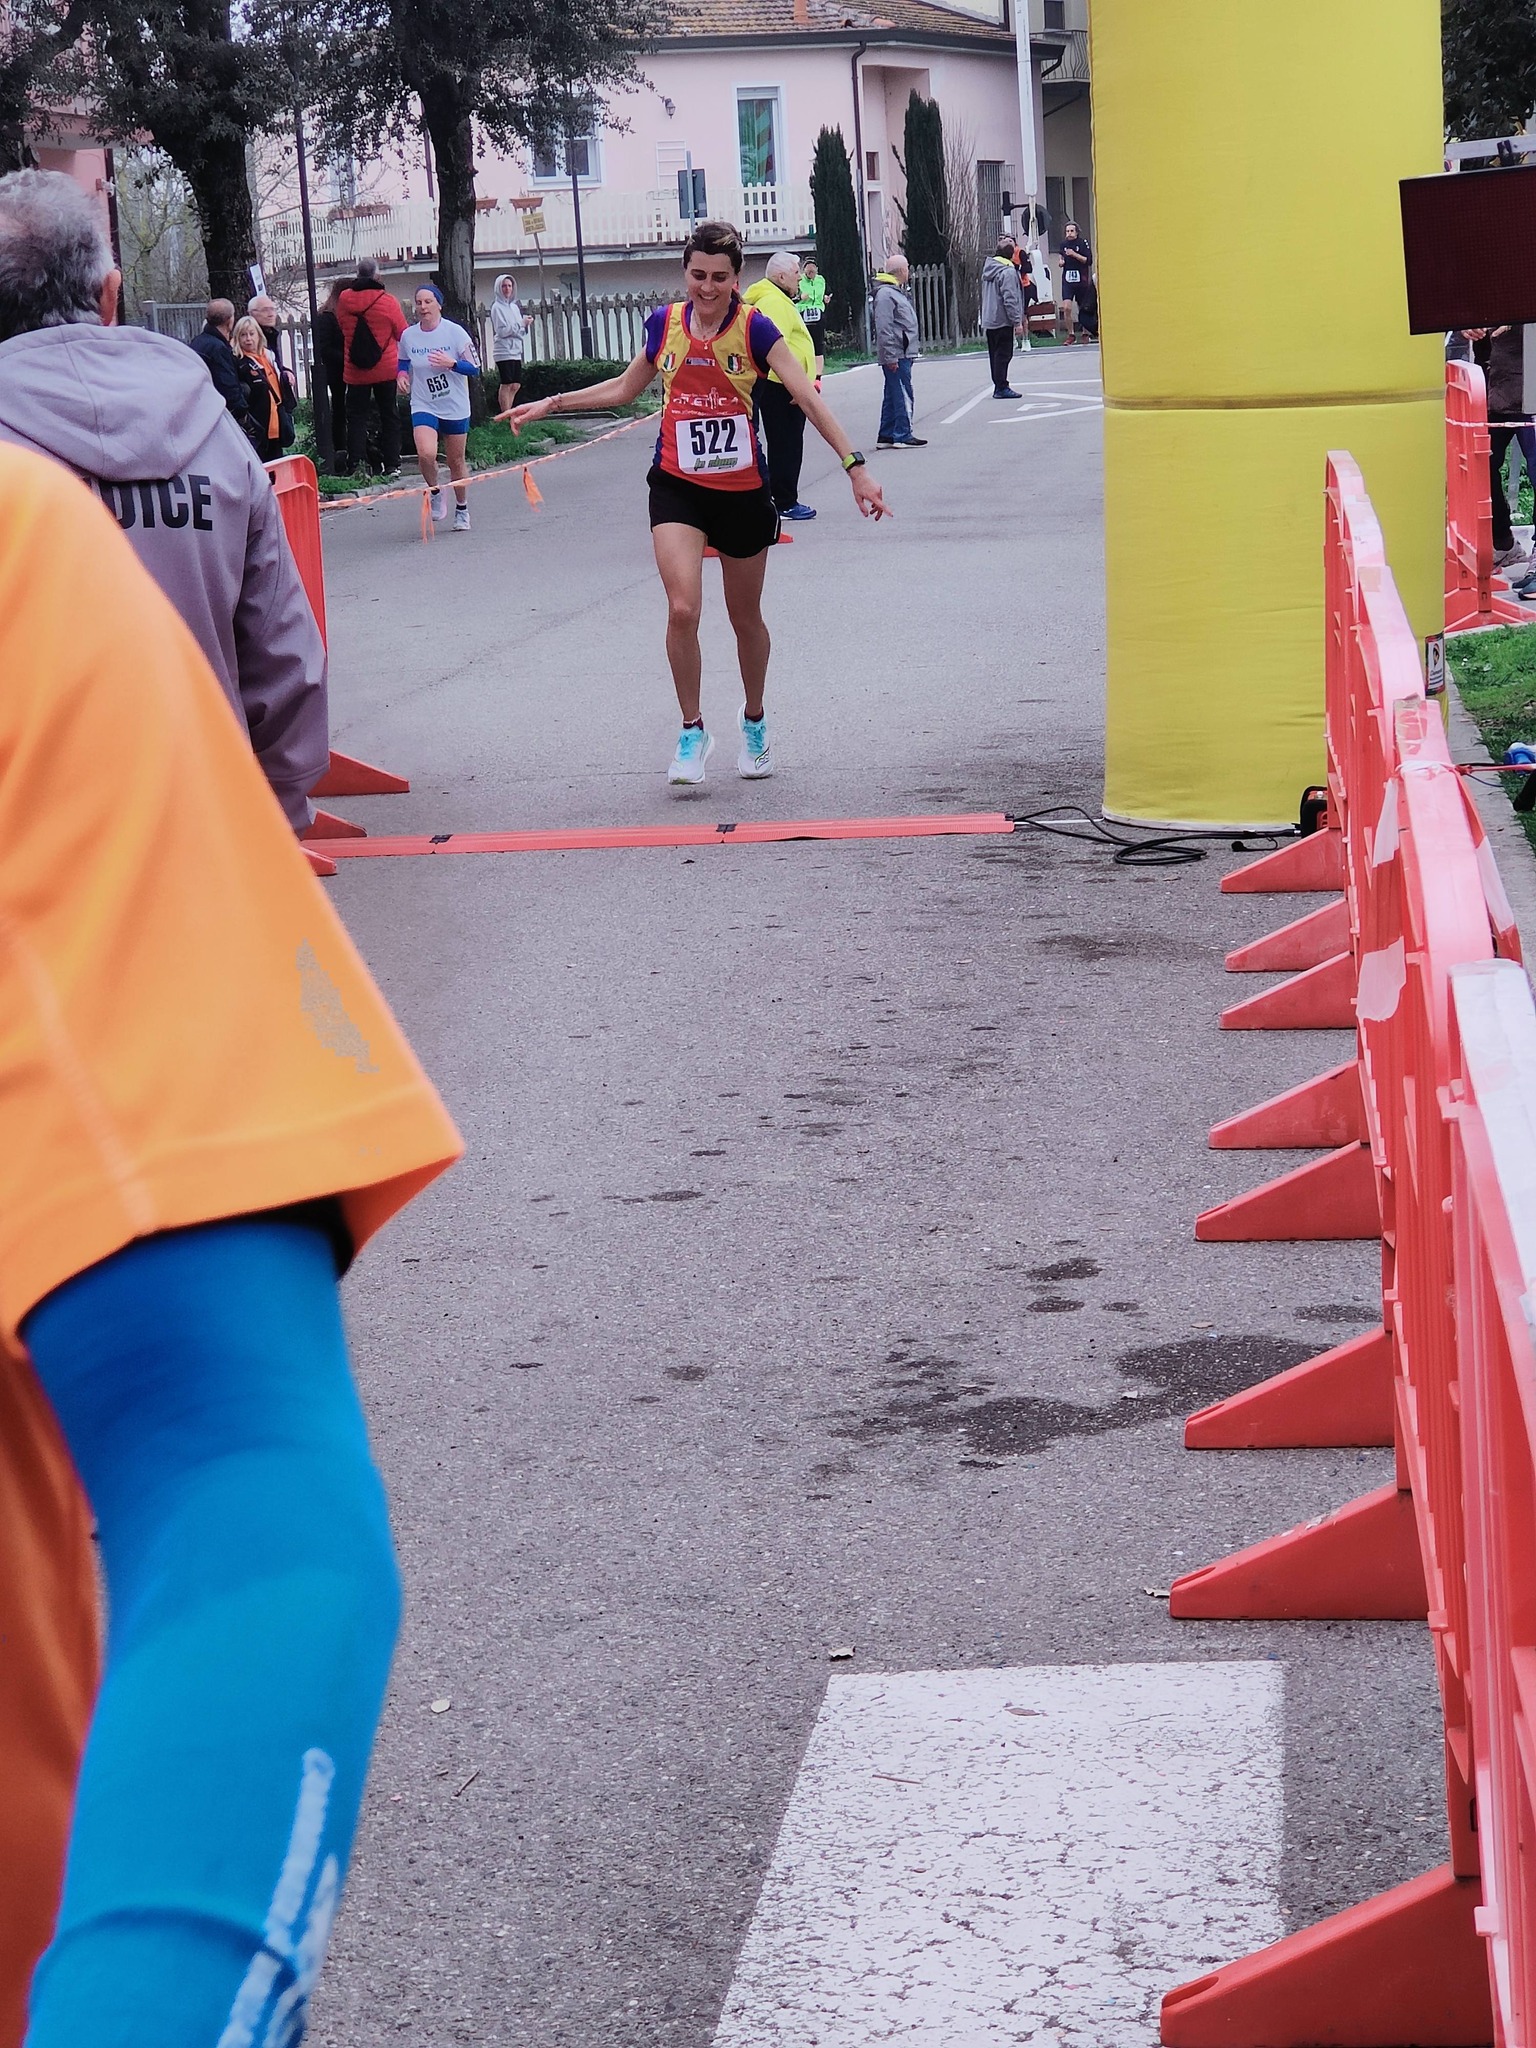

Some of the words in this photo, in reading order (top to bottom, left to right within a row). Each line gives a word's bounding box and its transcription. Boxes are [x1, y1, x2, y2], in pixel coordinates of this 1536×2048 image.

[426, 373, 449, 393] 653
[690, 418, 738, 456] 522
[82, 473, 213, 531] DICE
